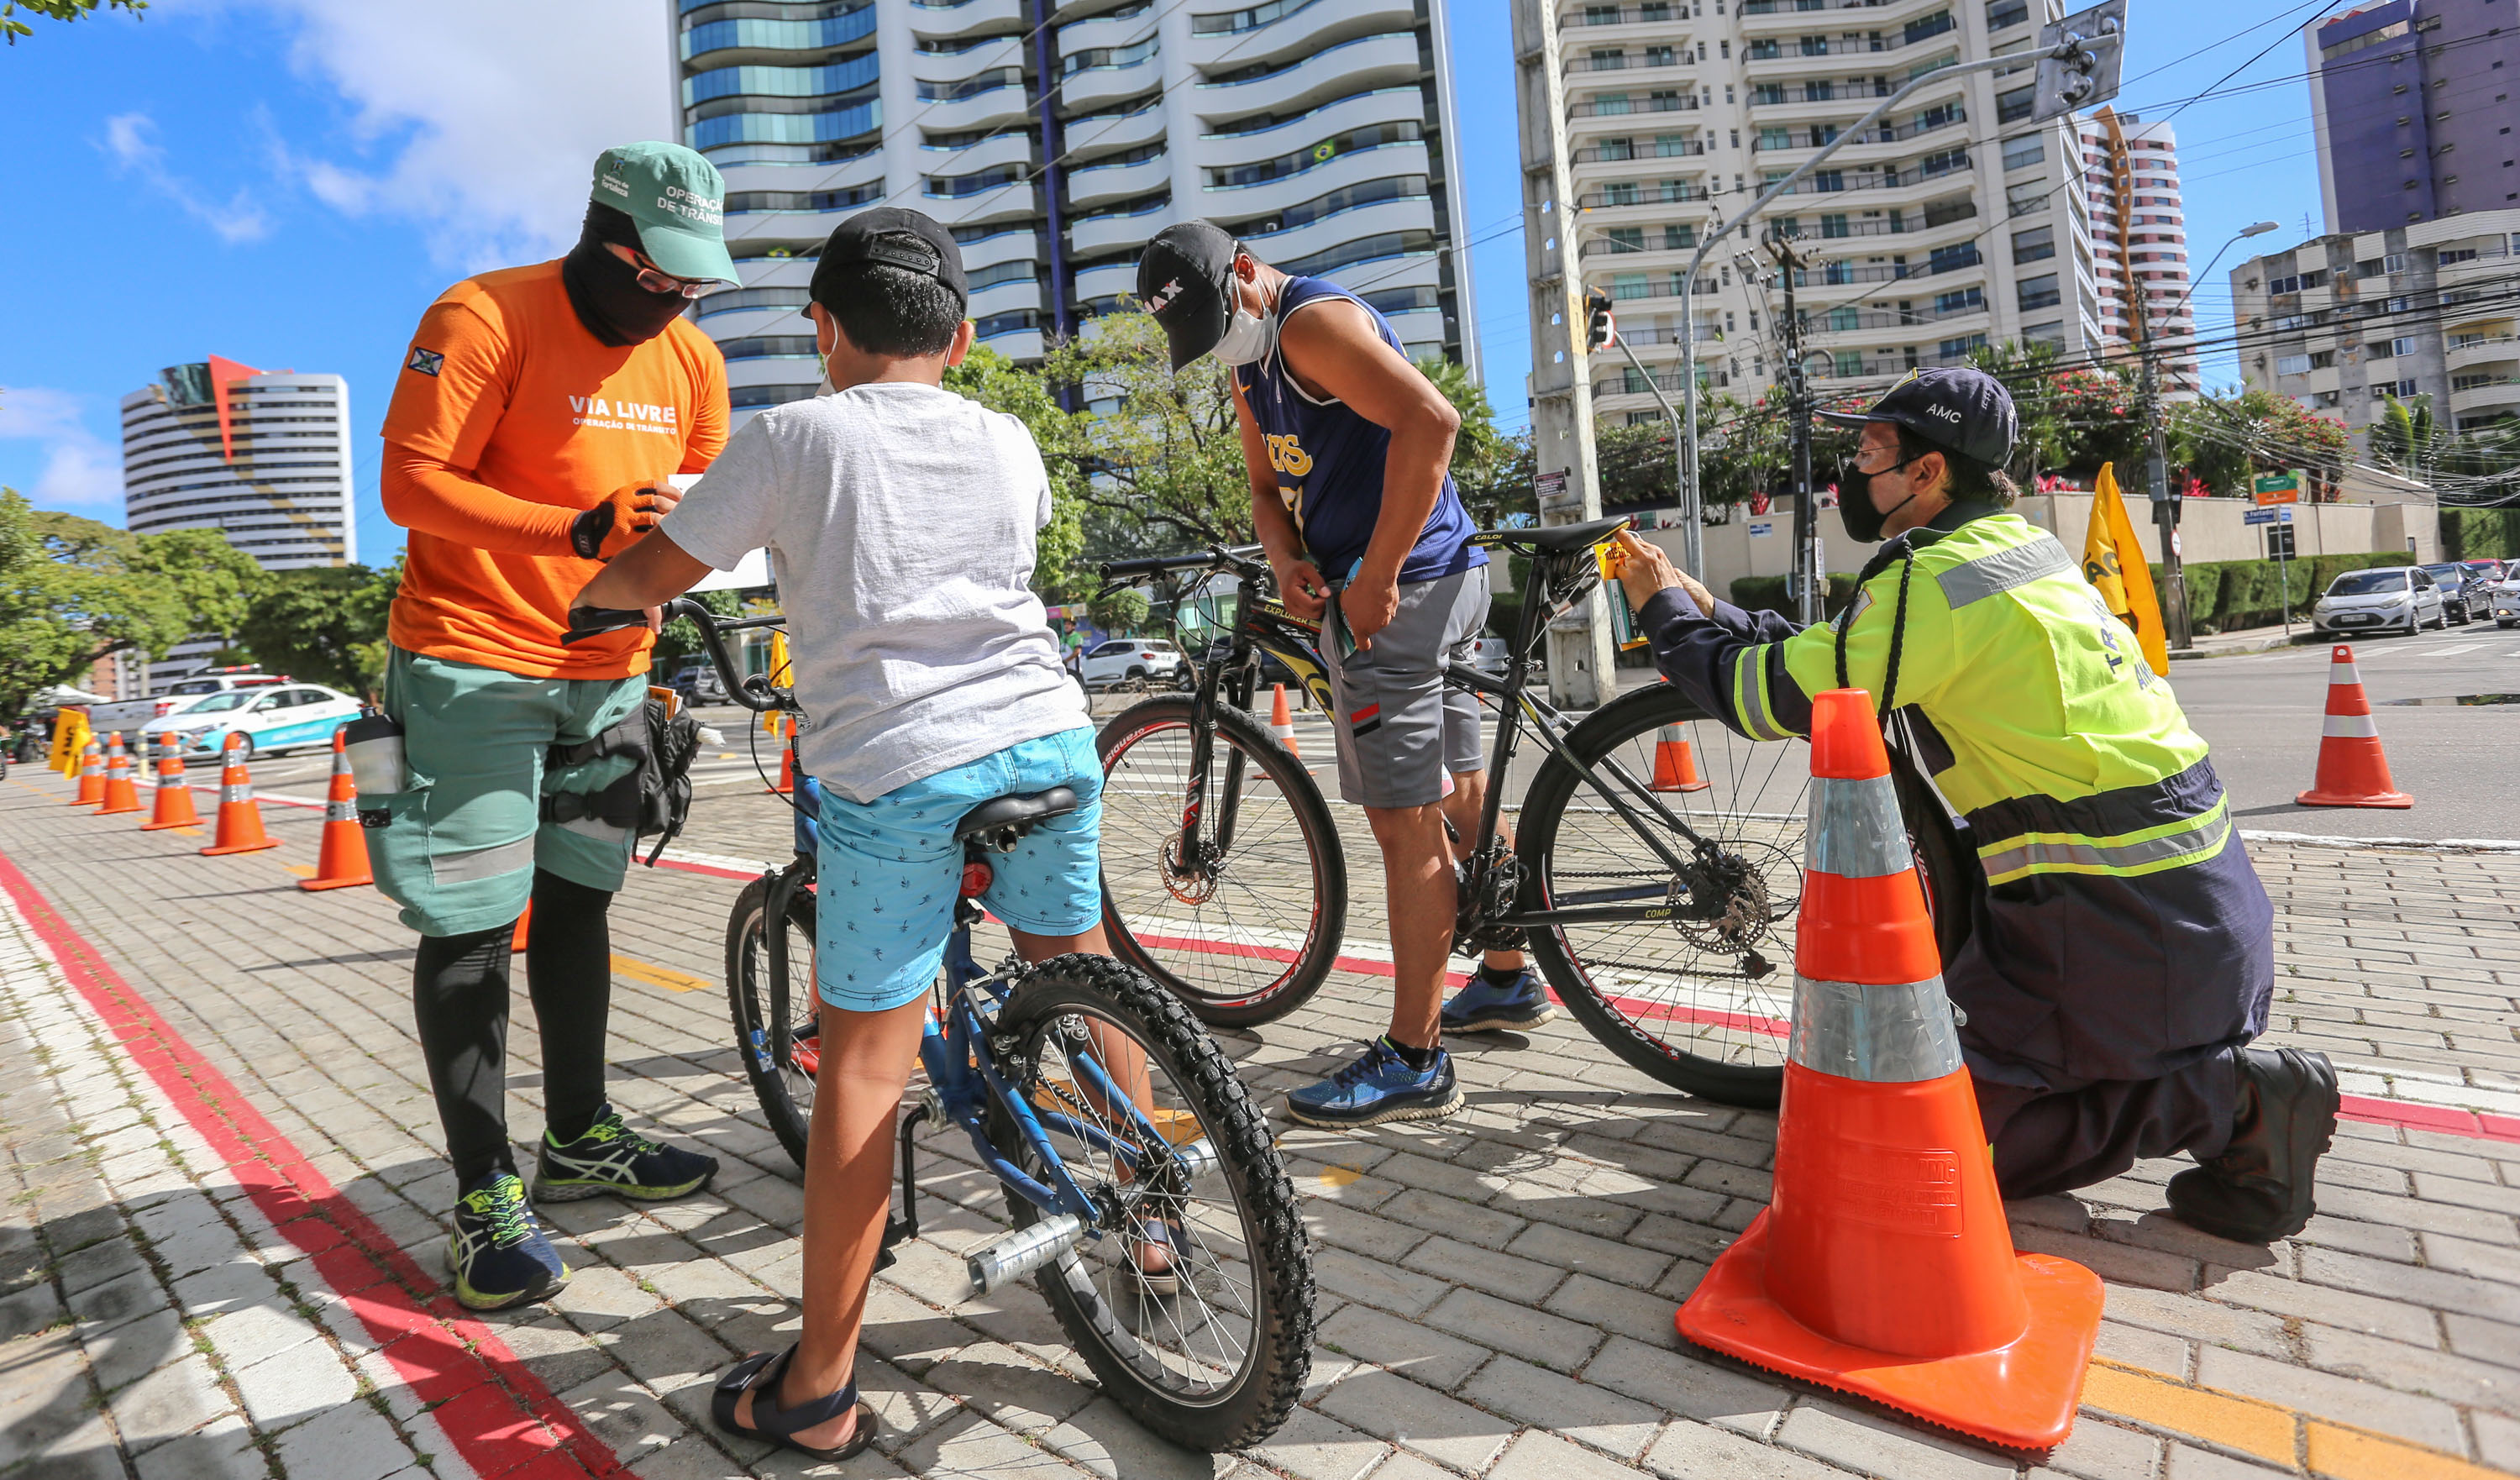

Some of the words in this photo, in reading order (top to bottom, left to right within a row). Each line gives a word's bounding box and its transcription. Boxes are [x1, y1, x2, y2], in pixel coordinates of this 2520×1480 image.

[658, 197, 676, 213] DE
[569, 395, 611, 417] VIA
[616, 401, 676, 424] LIVRE
[1926, 403, 1962, 423] AMC
[572, 417, 623, 430] OPERAÇÃO
[626, 422, 635, 431] DE
[636, 423, 677, 435] TRÂNSITO
[1646, 908, 1672, 918] COMP
